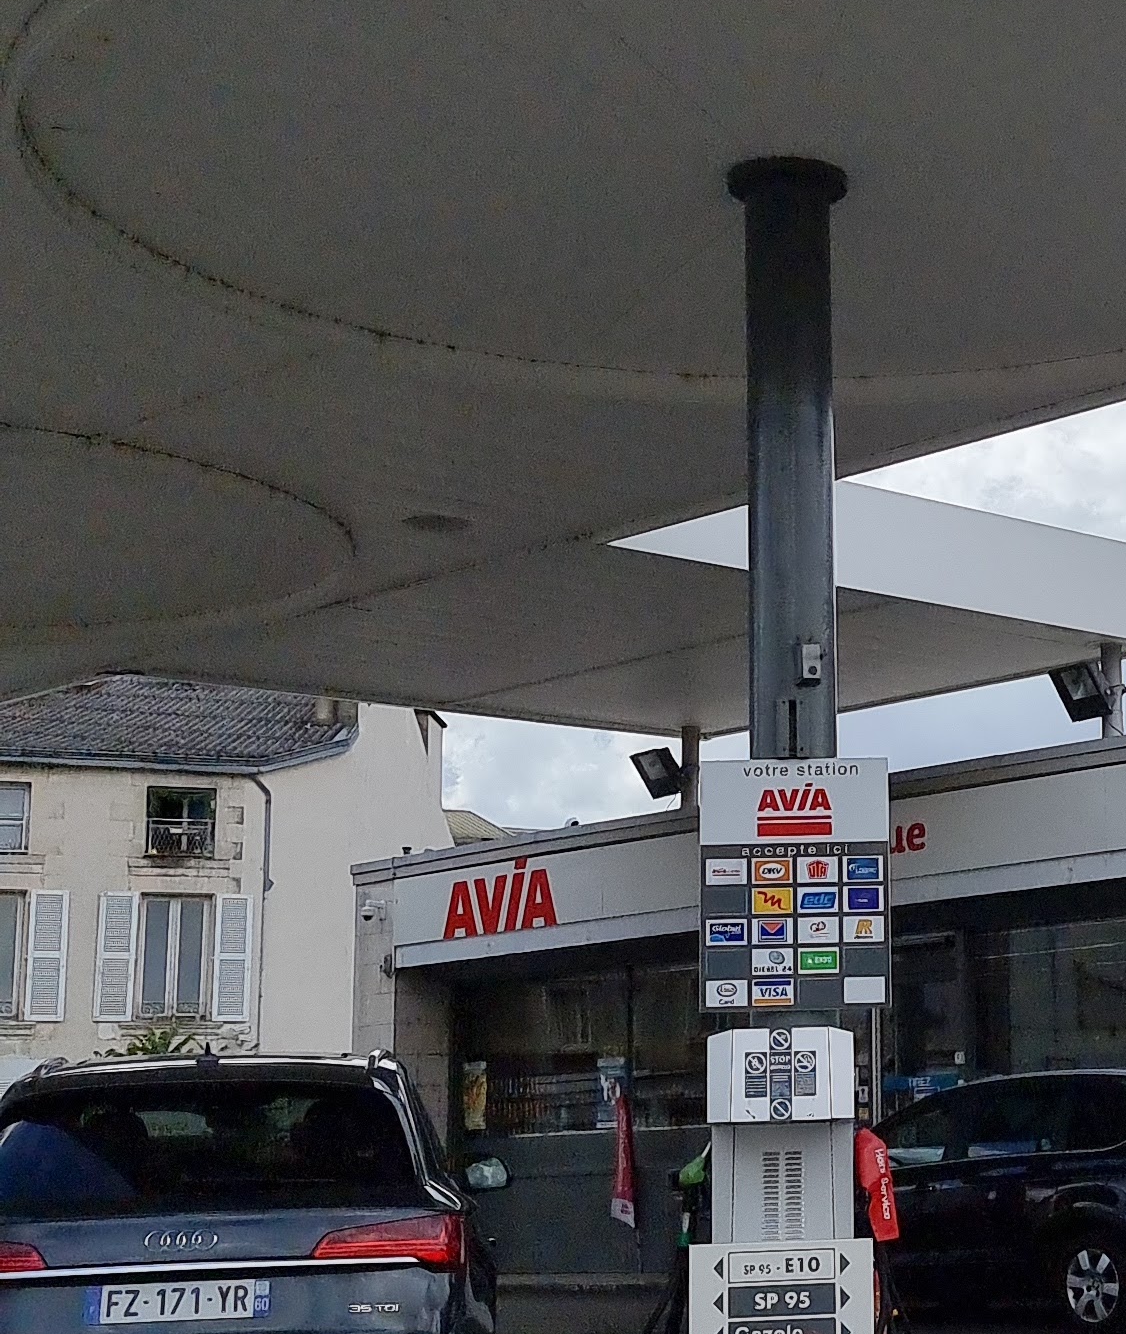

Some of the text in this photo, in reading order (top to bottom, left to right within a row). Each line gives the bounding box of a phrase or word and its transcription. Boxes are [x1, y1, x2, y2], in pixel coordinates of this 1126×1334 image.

[743, 763, 859, 777] votre station
[741, 844, 849, 858] accepte ici
[762, 867, 783, 875] DKV
[782, 965, 792, 973] 24
[759, 987, 789, 998] VISA
[743, 1264, 756, 1275] SP
[758, 1264, 772, 1275] 95
[785, 1256, 821, 1273] E10
[106, 1285, 249, 1318] FZ-171-YR
[254, 1297, 269, 1311] 60
[754, 1291, 811, 1310] SP 95
[348, 1303, 400, 1313] 35 TDI
